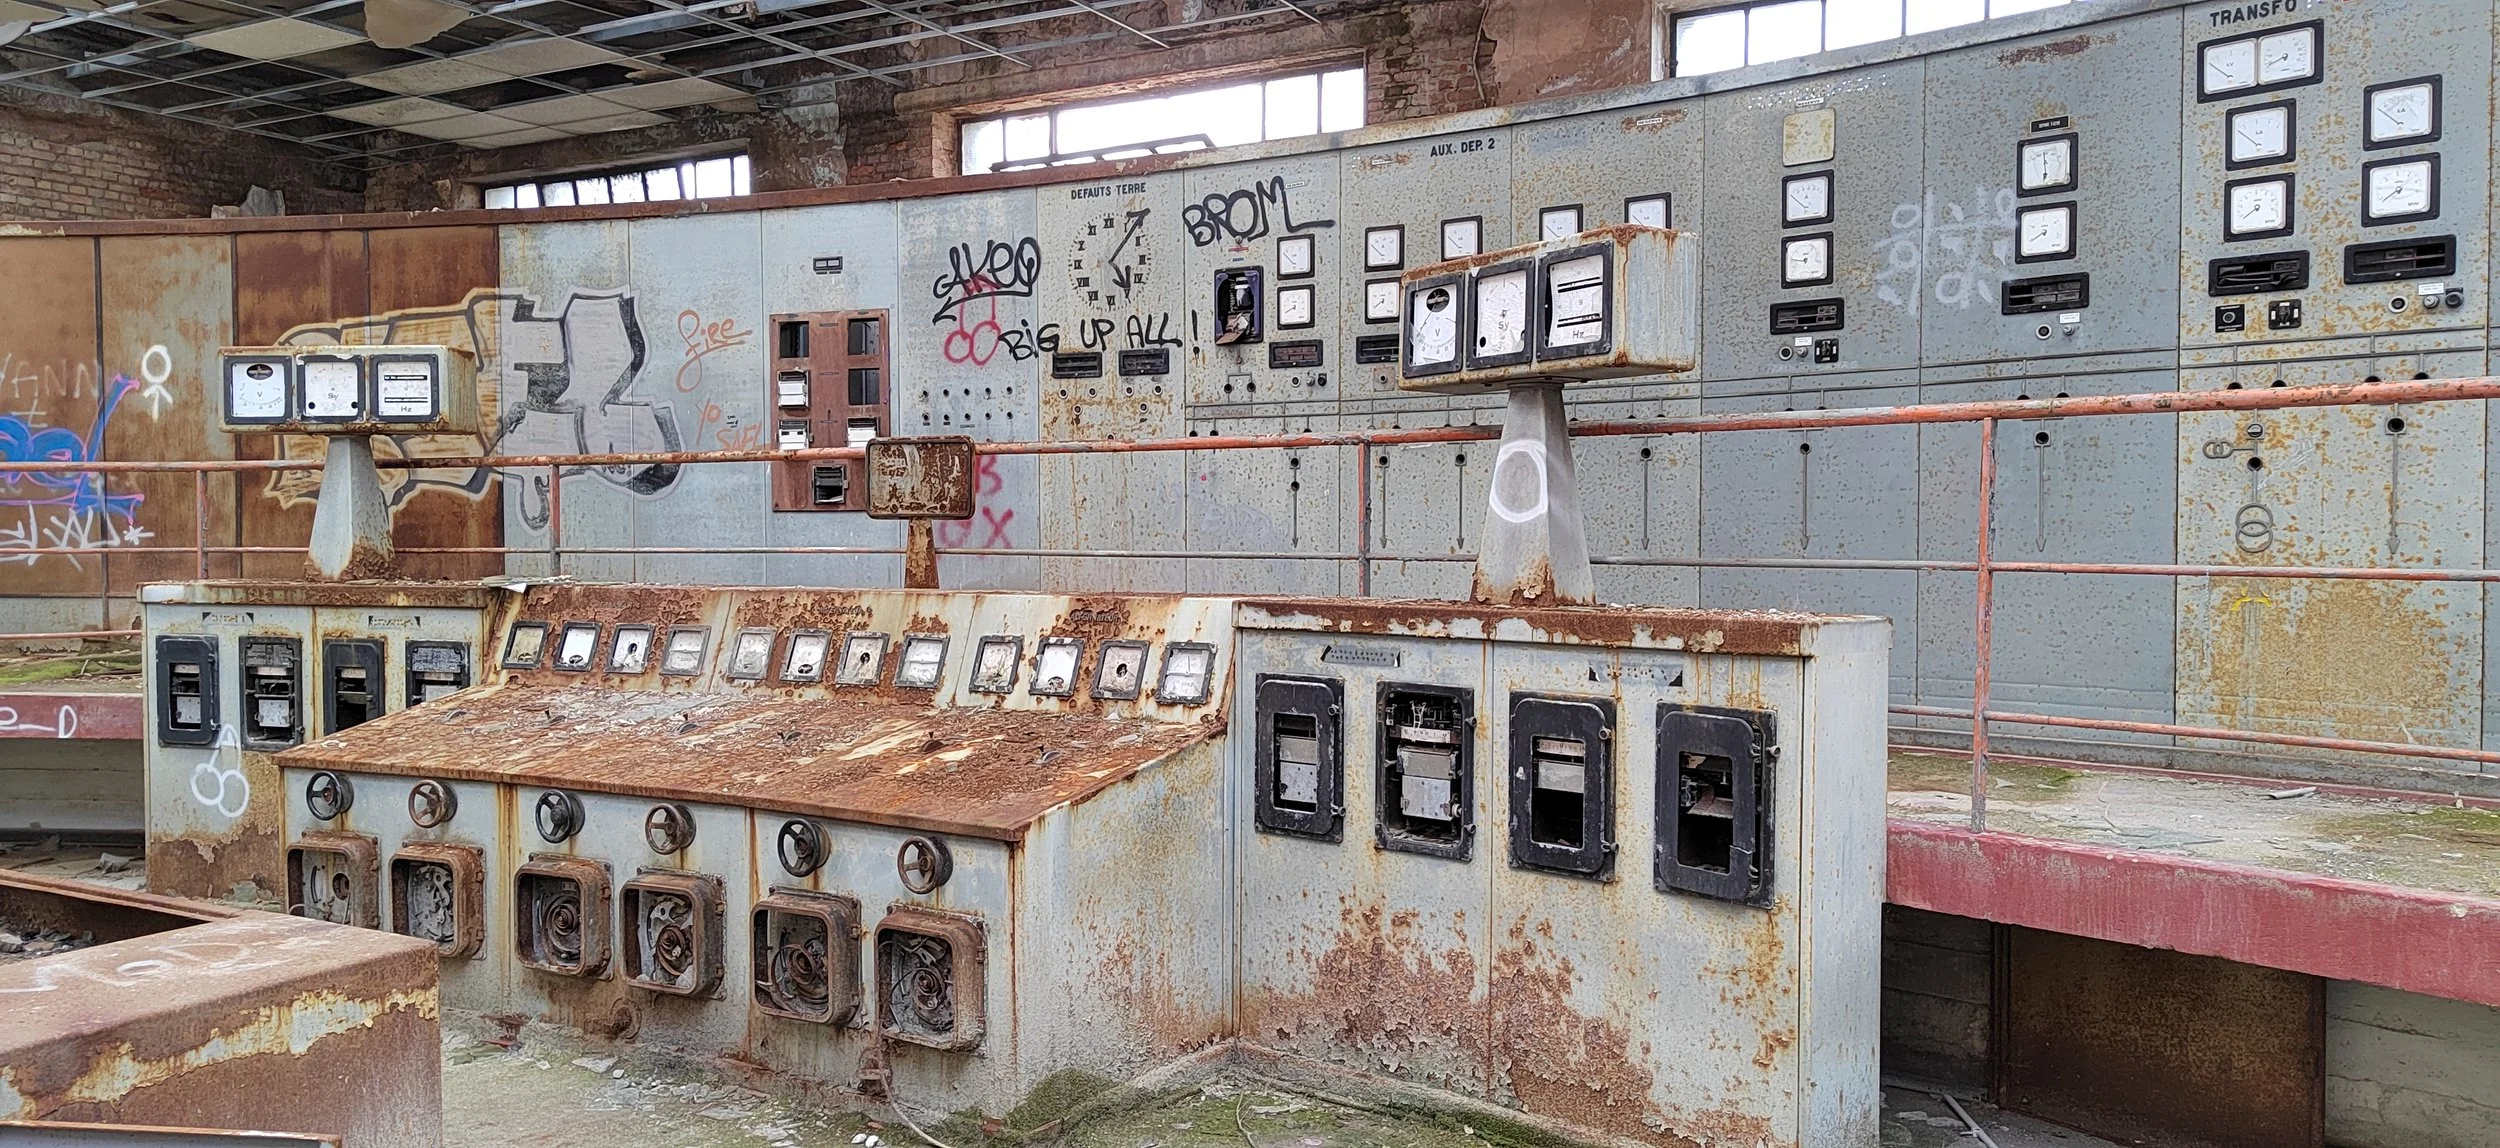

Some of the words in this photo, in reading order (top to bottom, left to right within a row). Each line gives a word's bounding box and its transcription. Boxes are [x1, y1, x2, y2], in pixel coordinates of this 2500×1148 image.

[2210, 0, 2297, 27] TRANSFO
[1430, 144, 1457, 158] AUX.
[1461, 139, 1484, 154] DEP.
[1487, 138, 1496, 150] 2
[1071, 186, 1112, 200] DEFAUTS
[1116, 182, 1147, 195] TERRE
[1103, 217, 1115, 228] XII
[1087, 225, 1097, 236] XI
[1077, 240, 1085, 251] X
[1133, 273, 1144, 284] IV
[1105, 295, 1116, 306] VI
[1080, 317, 1116, 351] UP
[1126, 312, 1183, 350] ALL
[1434, 327, 1442, 337] V
[1497, 321, 1510, 332] Sy
[1572, 329, 1585, 339] Hz
[327, 392, 340, 401] Sy
[400, 405, 413, 413] Hz
